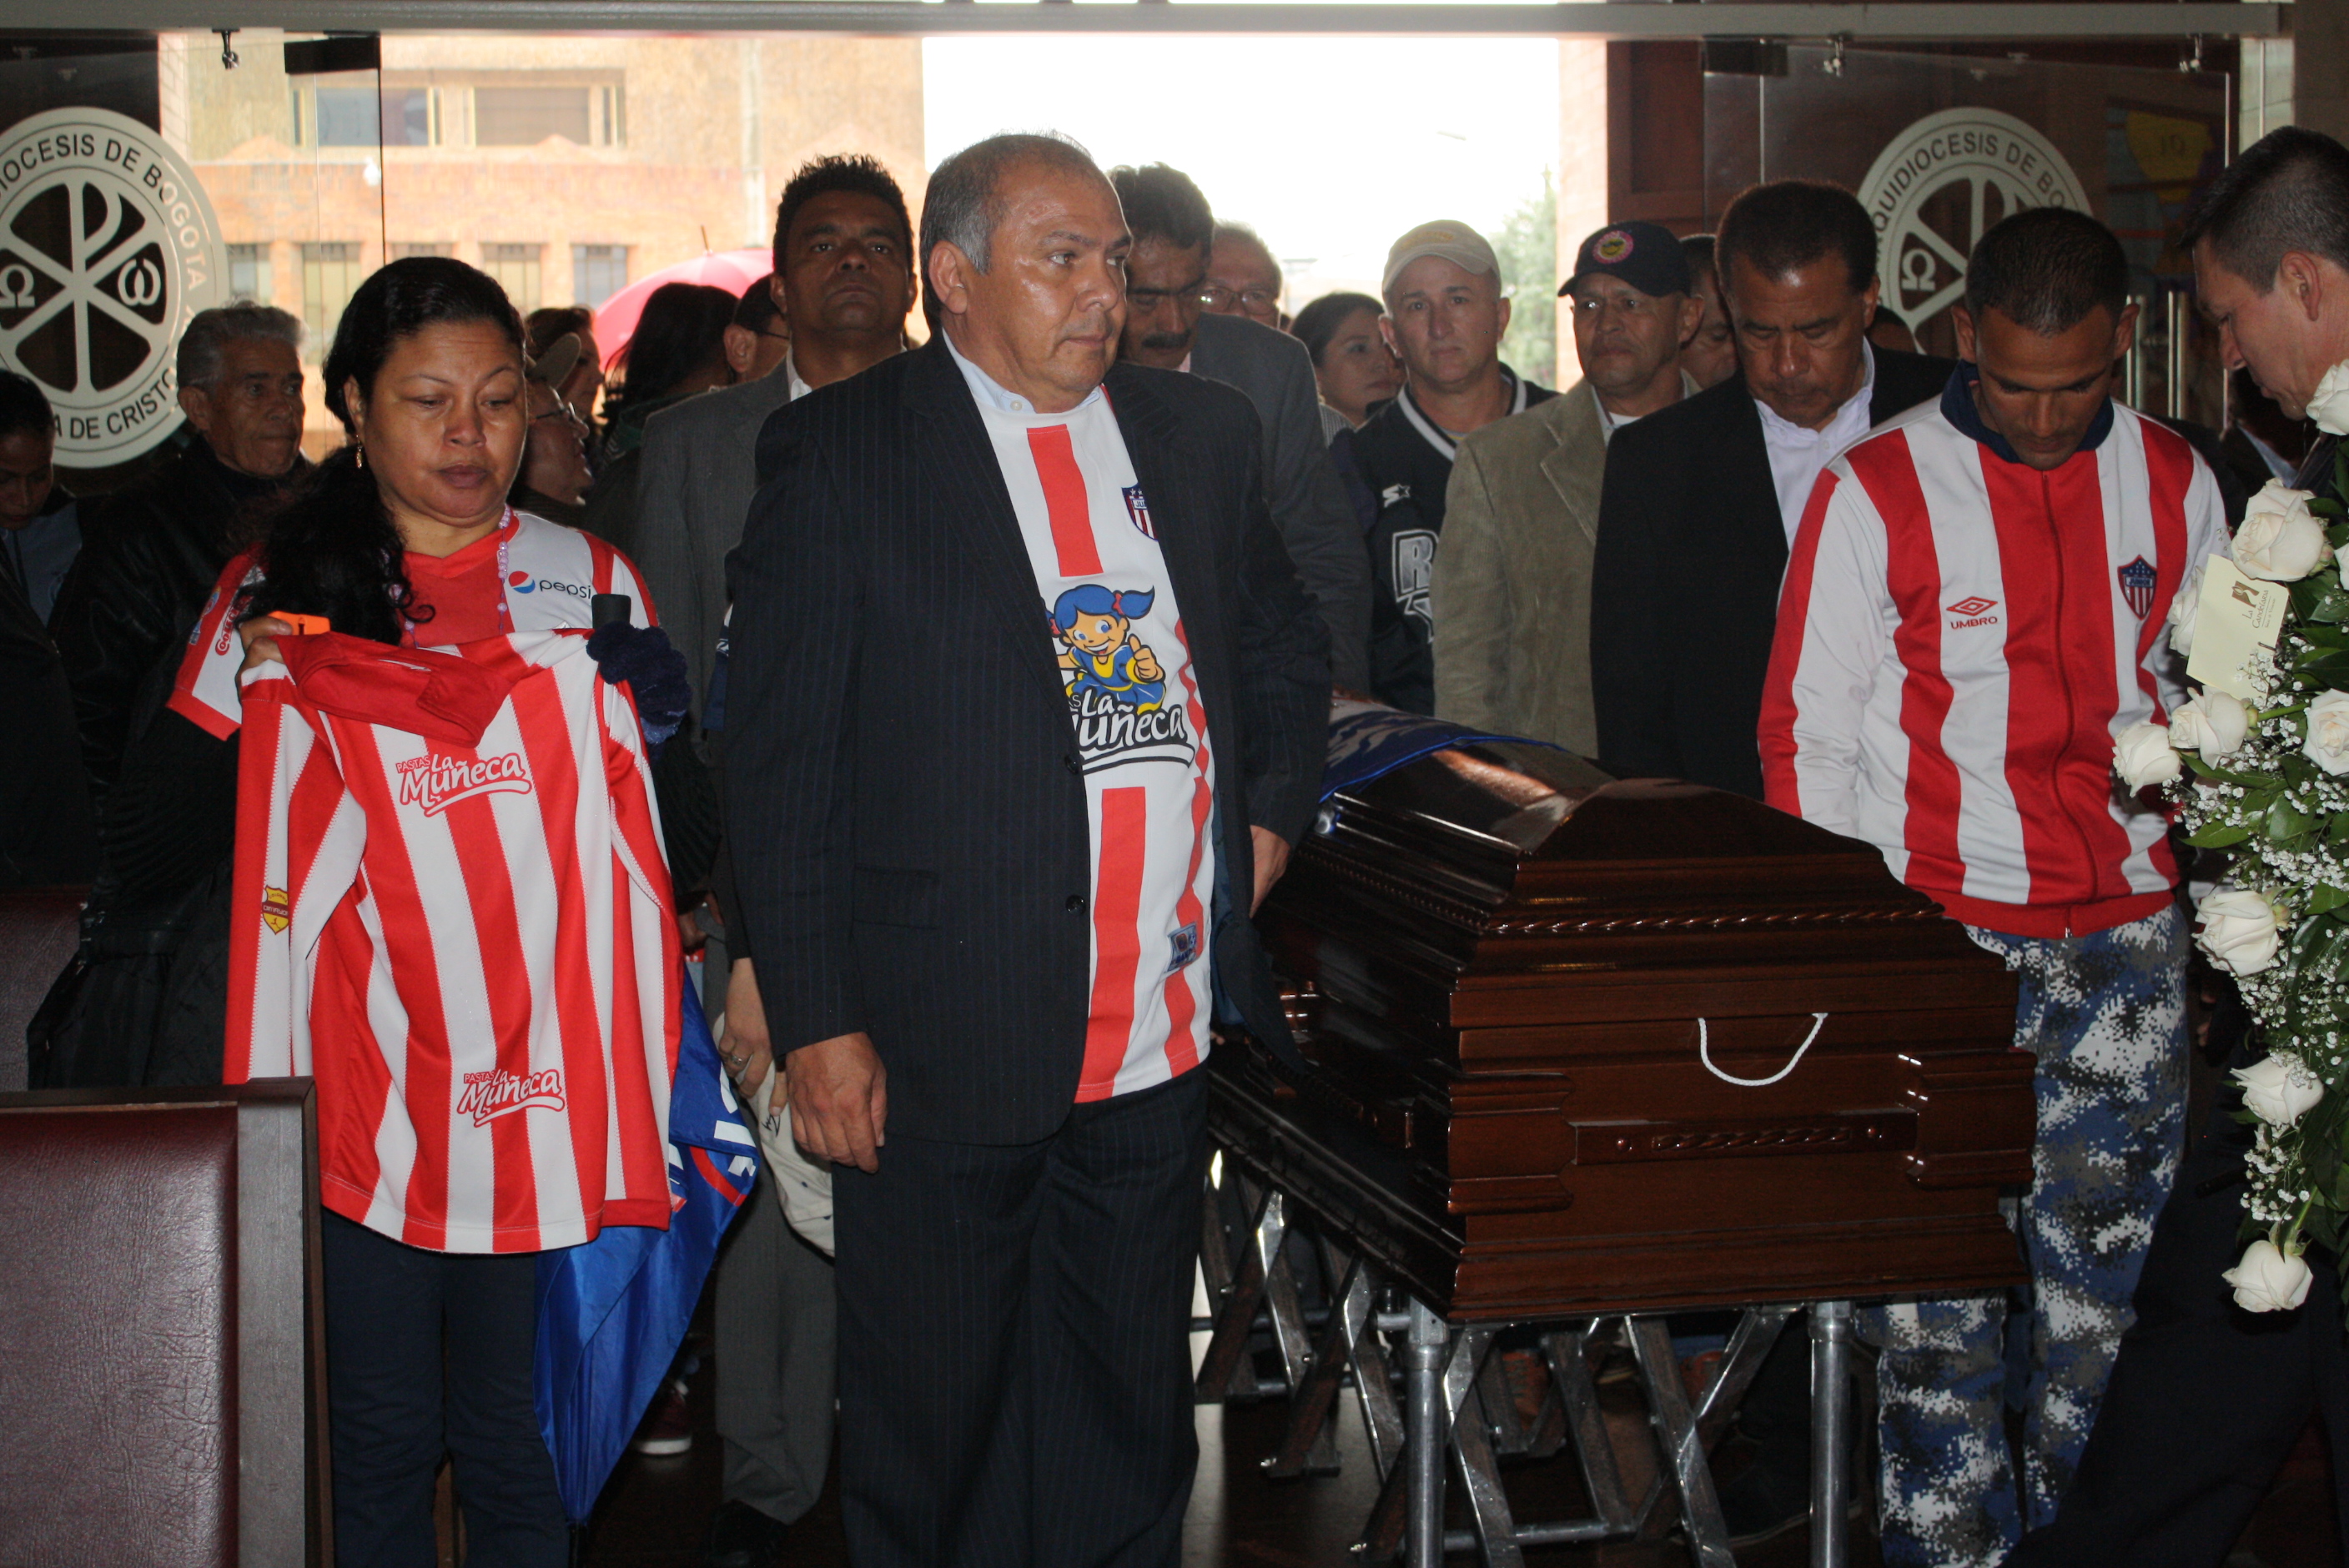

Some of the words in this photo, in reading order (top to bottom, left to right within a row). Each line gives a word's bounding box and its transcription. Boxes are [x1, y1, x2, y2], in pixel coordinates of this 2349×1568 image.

[1872, 131, 1998, 234] QUIDIOCESIS
[2006, 141, 2037, 177] DE
[0, 133, 96, 192] IOCESIS
[105, 138, 141, 173] DE
[143, 163, 207, 291] BOGOTA
[69, 417, 101, 440] DE
[539, 580, 591, 600] pepsi
[1950, 616, 1999, 630] UMBRO
[1081, 688, 1115, 717] La
[1072, 704, 1185, 747] uñeca
[396, 755, 431, 774] PASTAS
[430, 753, 454, 772] La
[400, 754, 526, 808] Muñeca
[464, 1071, 495, 1083] PASTAS
[493, 1068, 509, 1086] La
[459, 1070, 561, 1119] Muñeca
